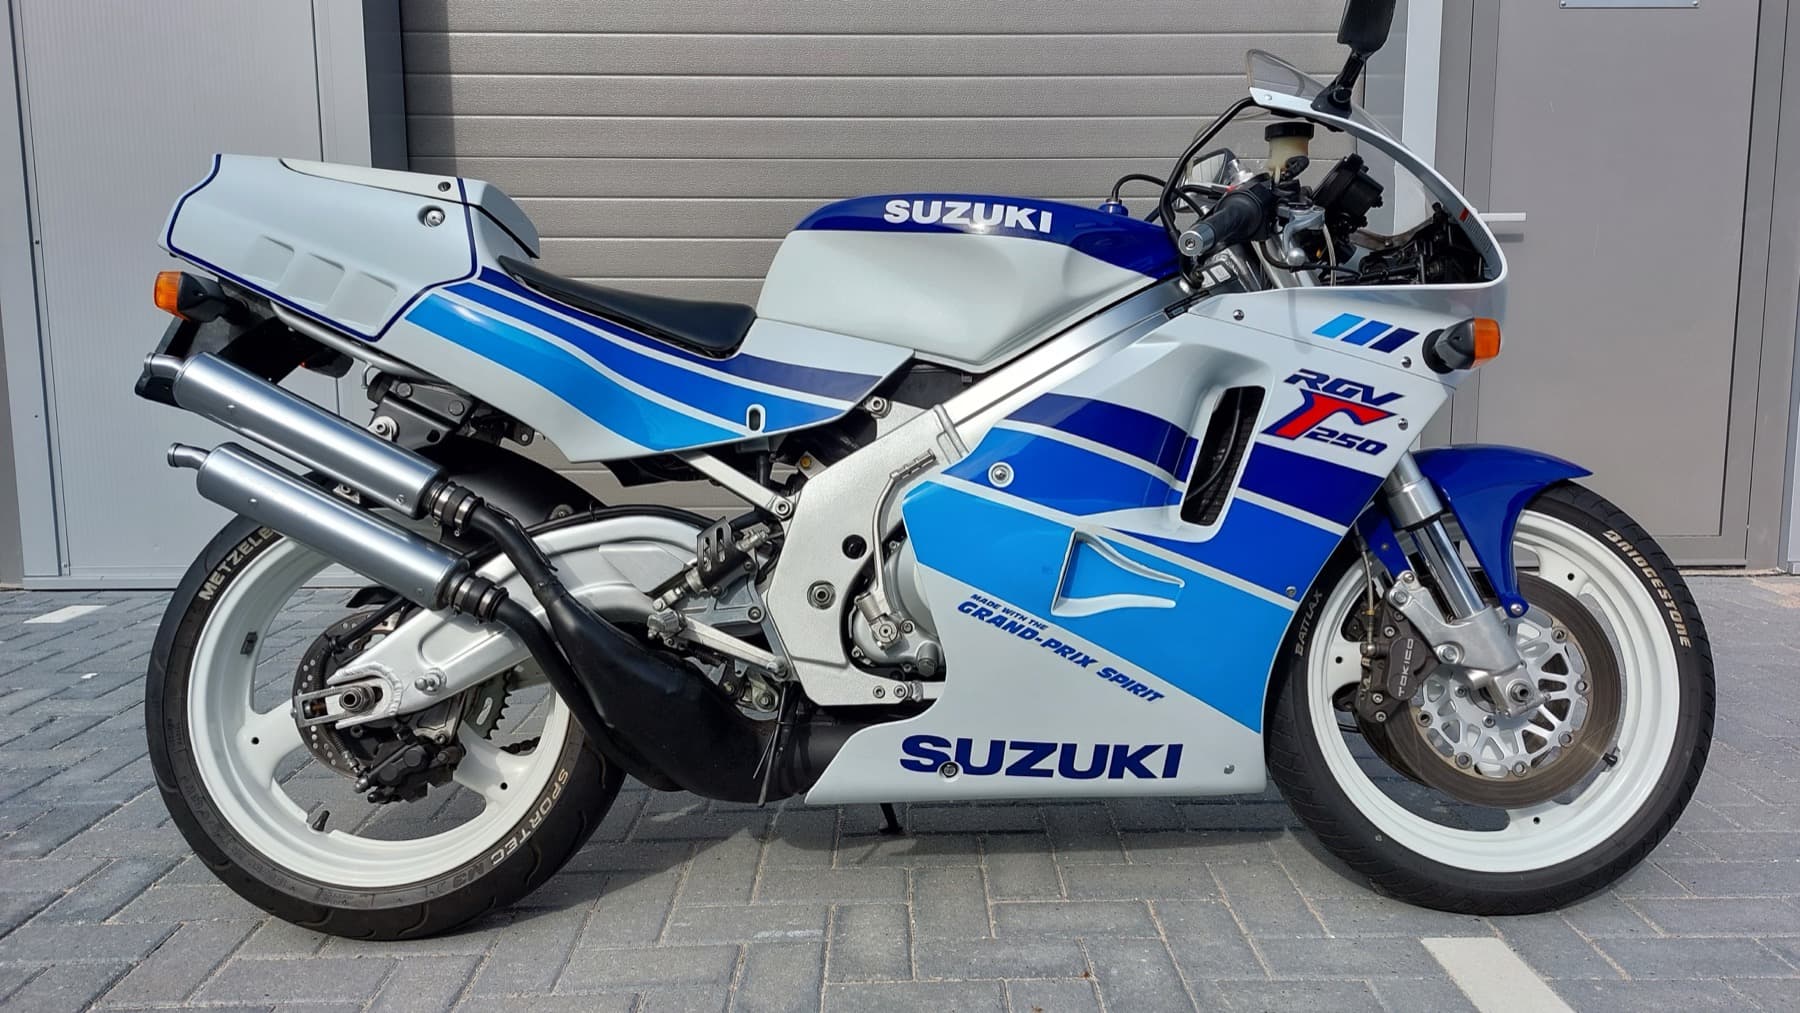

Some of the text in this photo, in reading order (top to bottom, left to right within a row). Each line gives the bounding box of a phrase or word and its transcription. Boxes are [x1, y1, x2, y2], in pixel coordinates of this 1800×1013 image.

[884, 199, 1053, 234] SUZUKI
[1283, 368, 1406, 406] RGV
[1303, 426, 1388, 456] 250
[198, 527, 274, 601] METZELE
[1602, 529, 1692, 649] BRIDGESTONE
[970, 593, 1049, 631] MADE WITH THE
[1295, 588, 1323, 657] BATTLAX
[957, 601, 1165, 702] GRAND-PRIX SPIRIT
[1398, 638, 1414, 697] TOKICO
[899, 734, 1184, 780] SUZUKI
[490, 768, 569, 866] SPORTEC
